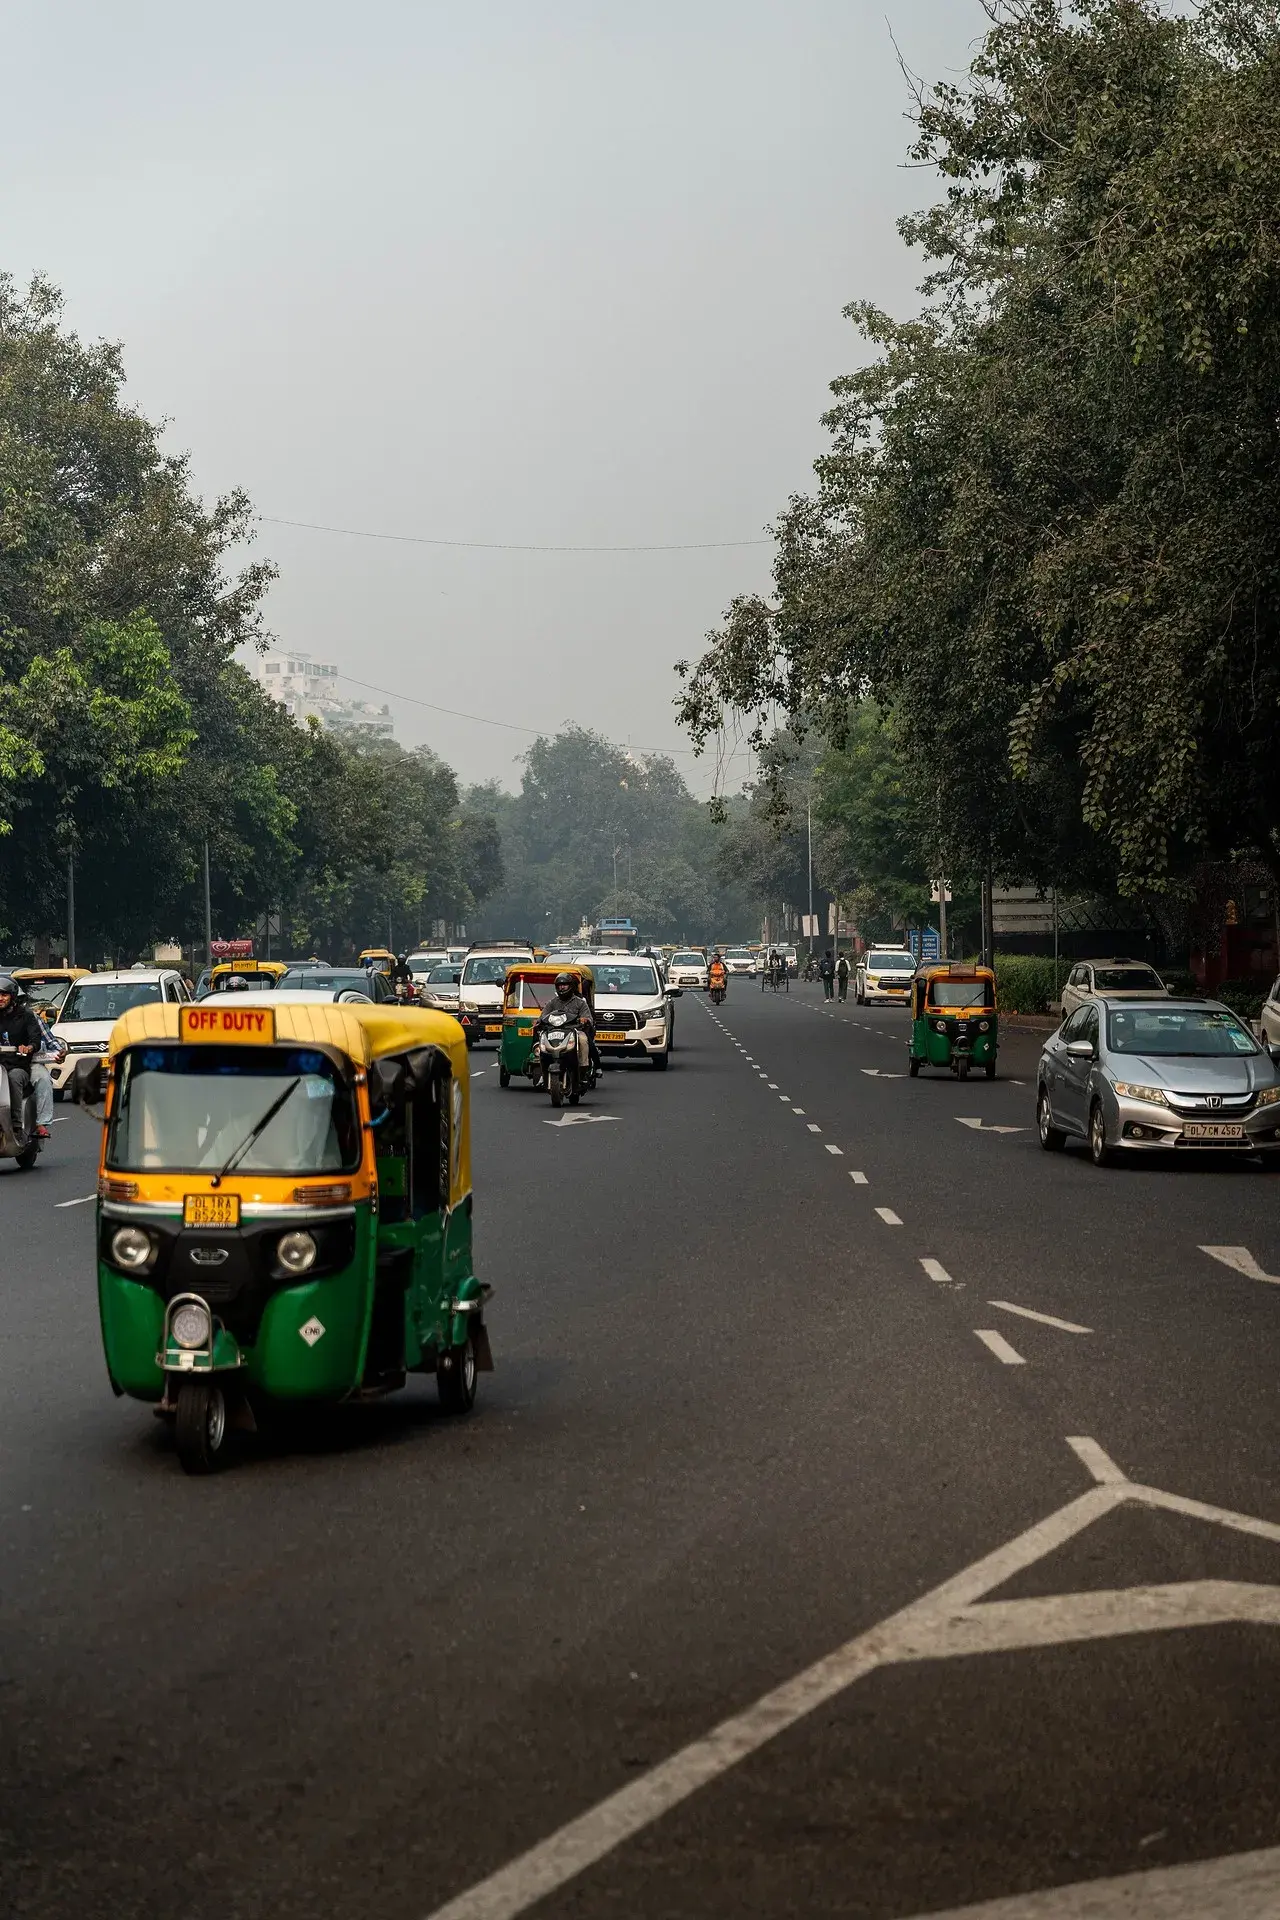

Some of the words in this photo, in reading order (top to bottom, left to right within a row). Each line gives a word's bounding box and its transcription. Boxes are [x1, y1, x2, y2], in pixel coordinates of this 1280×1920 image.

[188, 1012, 218, 1030] OFF
[223, 1012, 265, 1031] DUTY
[1221, 1126, 1242, 1136] 4567
